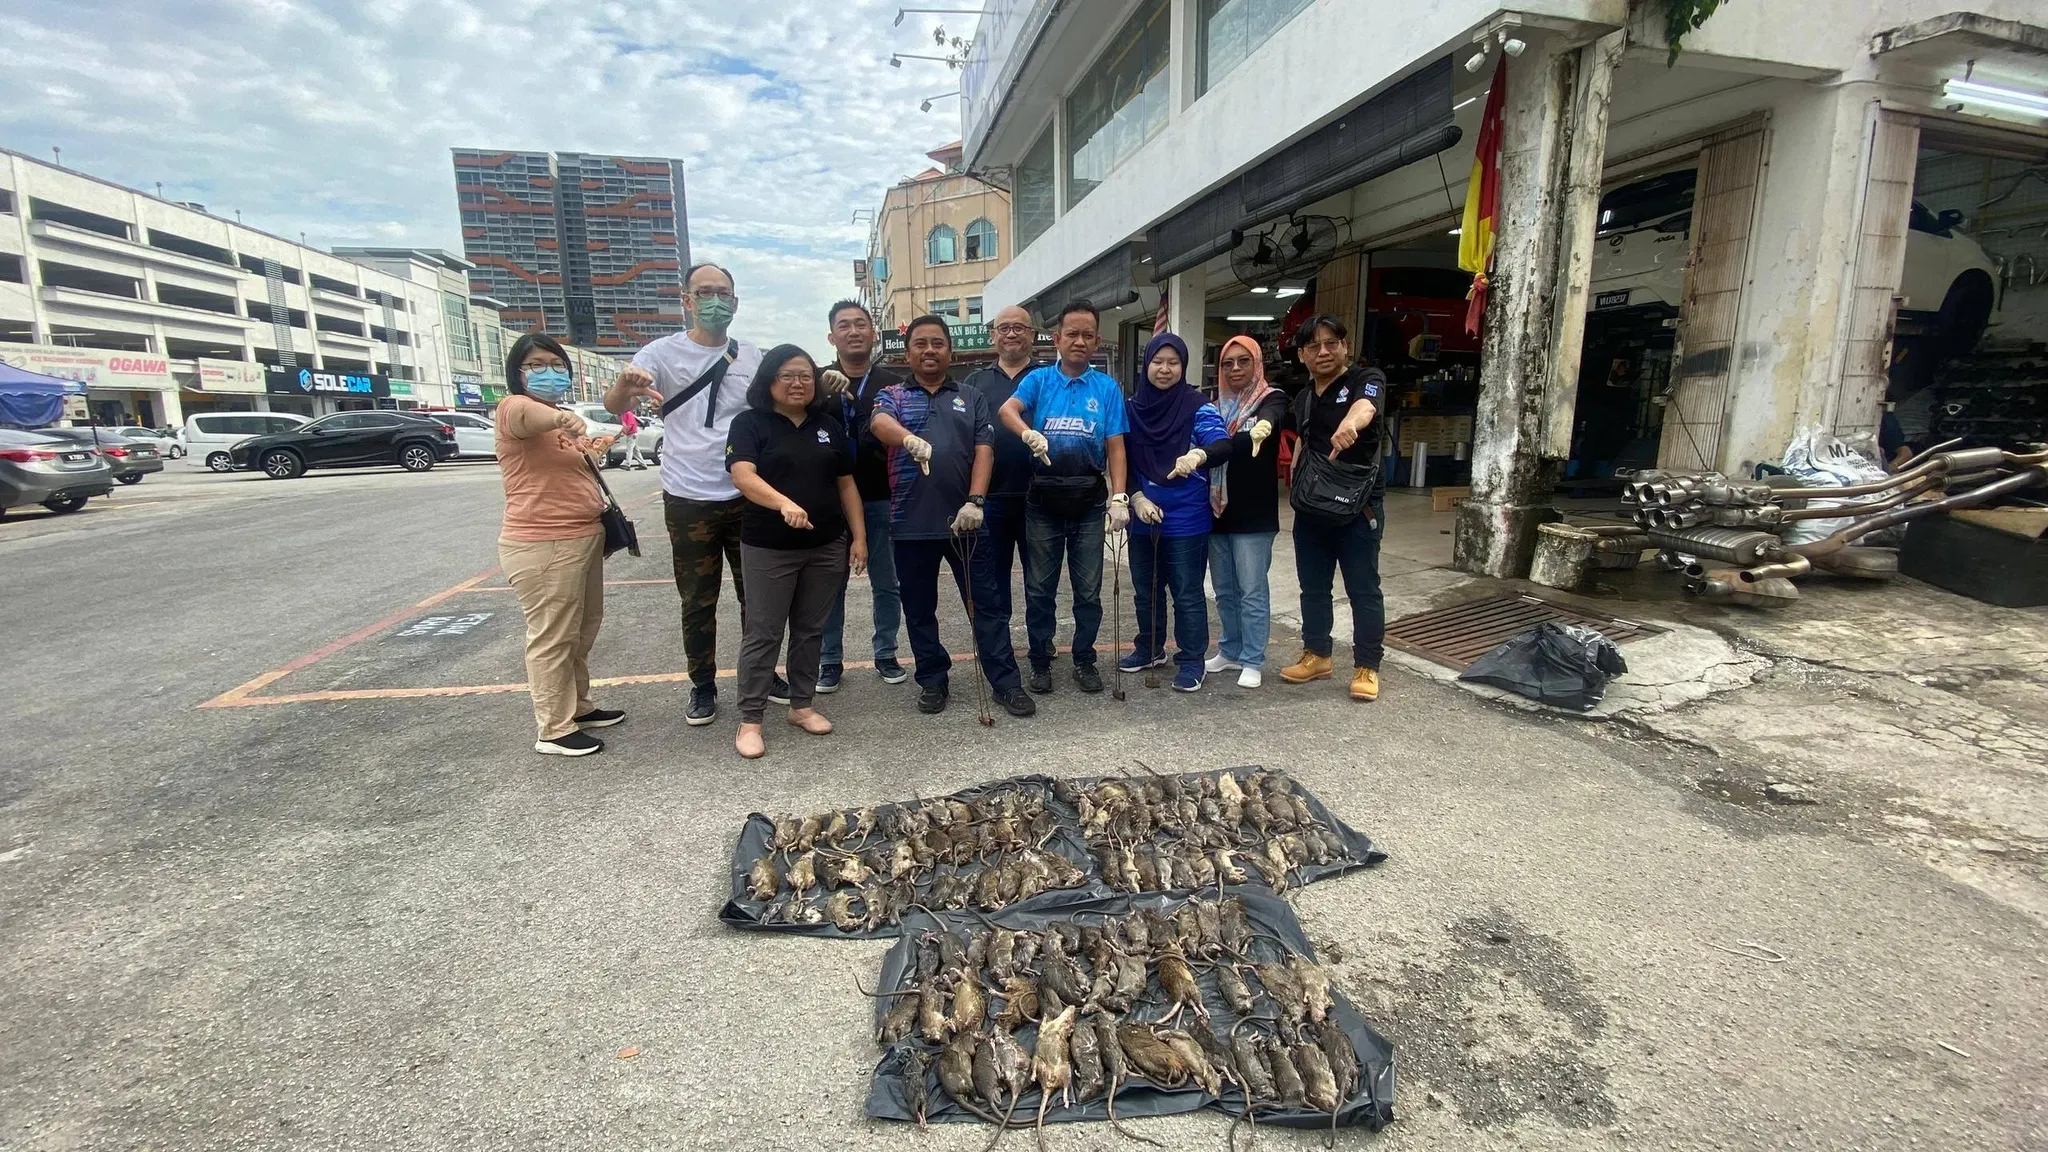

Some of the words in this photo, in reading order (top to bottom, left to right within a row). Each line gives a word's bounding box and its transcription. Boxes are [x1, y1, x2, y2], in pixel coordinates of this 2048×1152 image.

[949, 325, 963, 336] RAN
[965, 326, 977, 335] BIG
[979, 325, 988, 334] FA
[952, 336, 995, 347] 美食中心
[1037, 333, 1053, 341] ne
[885, 339, 905, 349] Hein
[109, 357, 167, 373] OGAWA
[313, 373, 372, 393] SOLECAR
[1043, 417, 1097, 433] MBSJ
